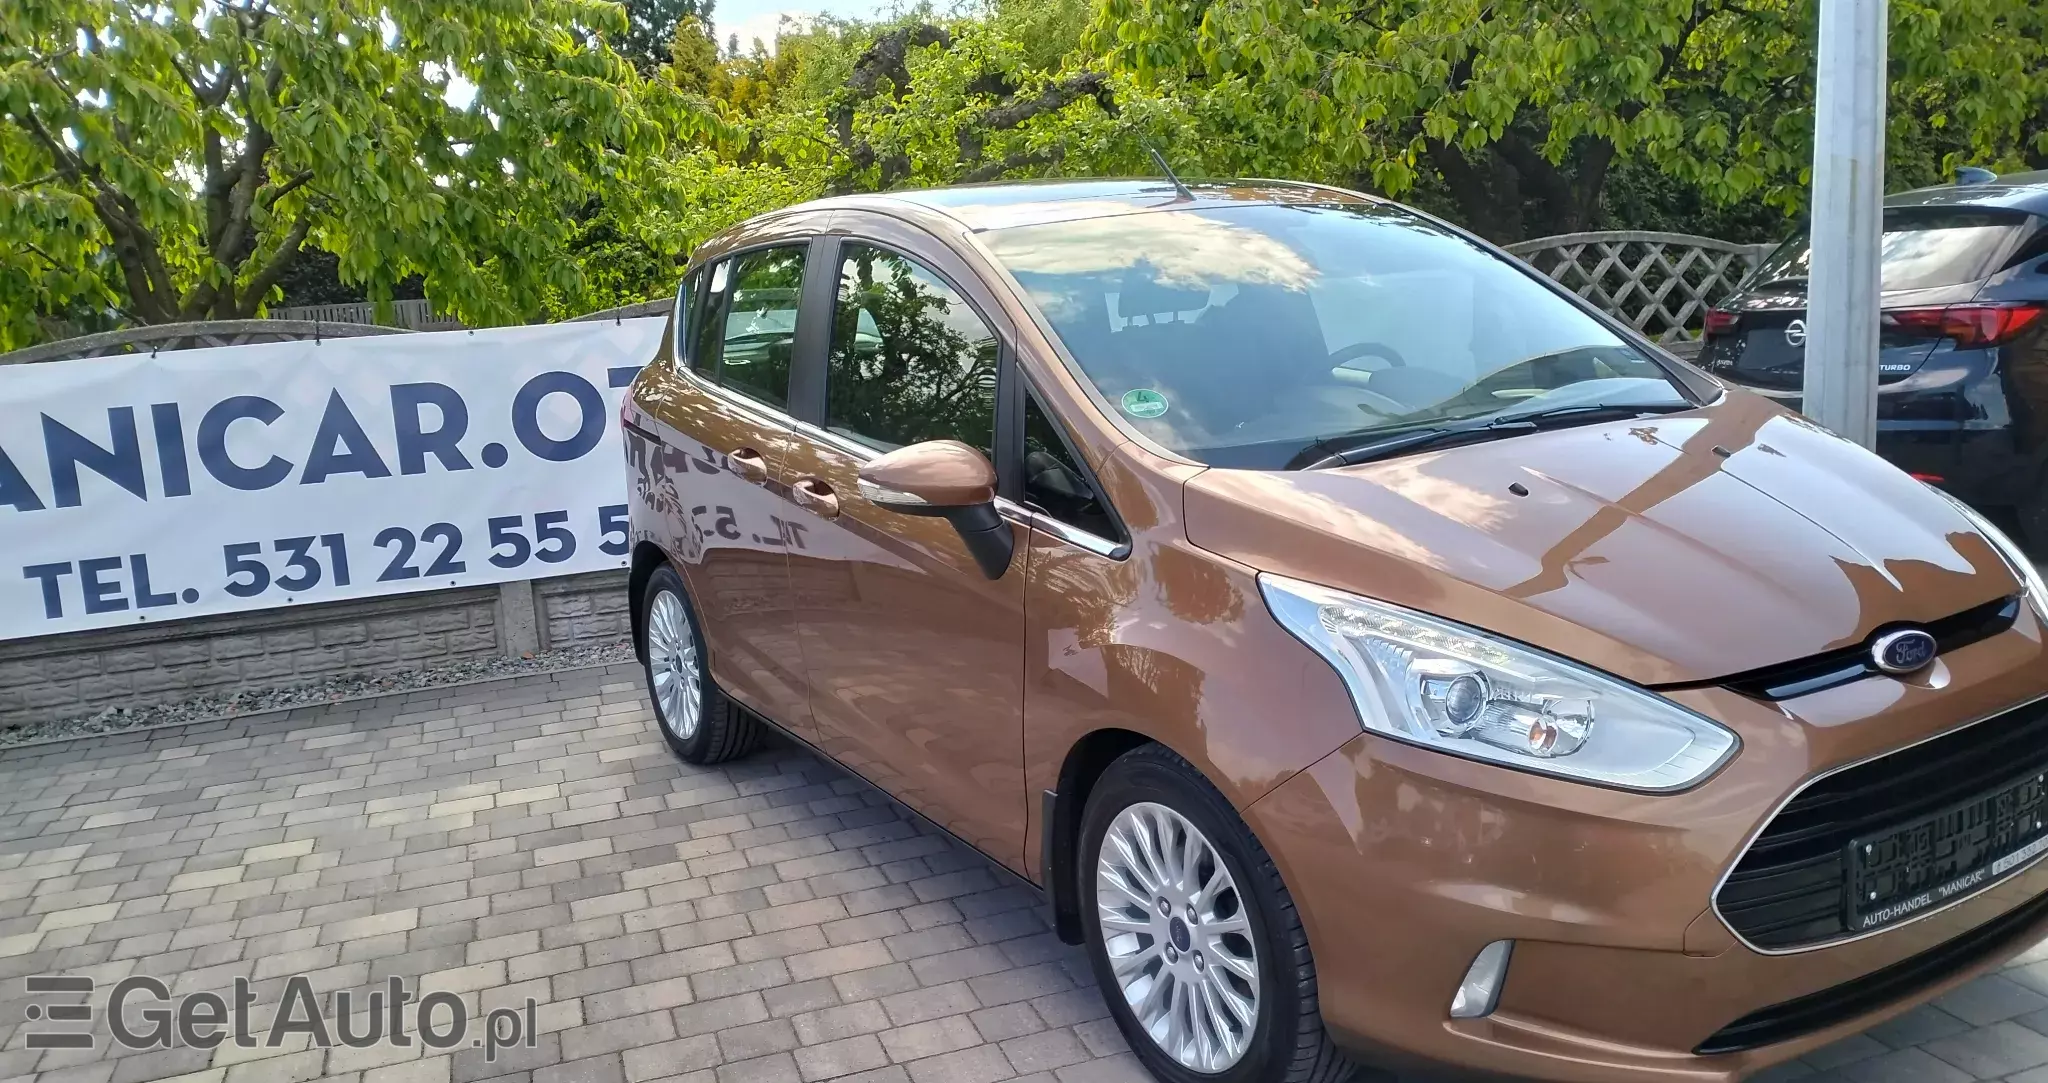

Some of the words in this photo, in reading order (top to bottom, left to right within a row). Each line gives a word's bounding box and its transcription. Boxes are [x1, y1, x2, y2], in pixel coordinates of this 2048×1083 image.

[23, 553, 200, 619] TEL.
[223, 532, 350, 599] 531
[372, 522, 467, 581] 22
[488, 509, 577, 568] 55
[1896, 638, 1927, 664] Ford
[1862, 893, 1932, 928] AUTO-HANDEL
[1938, 869, 1985, 899] "MANICAR"
